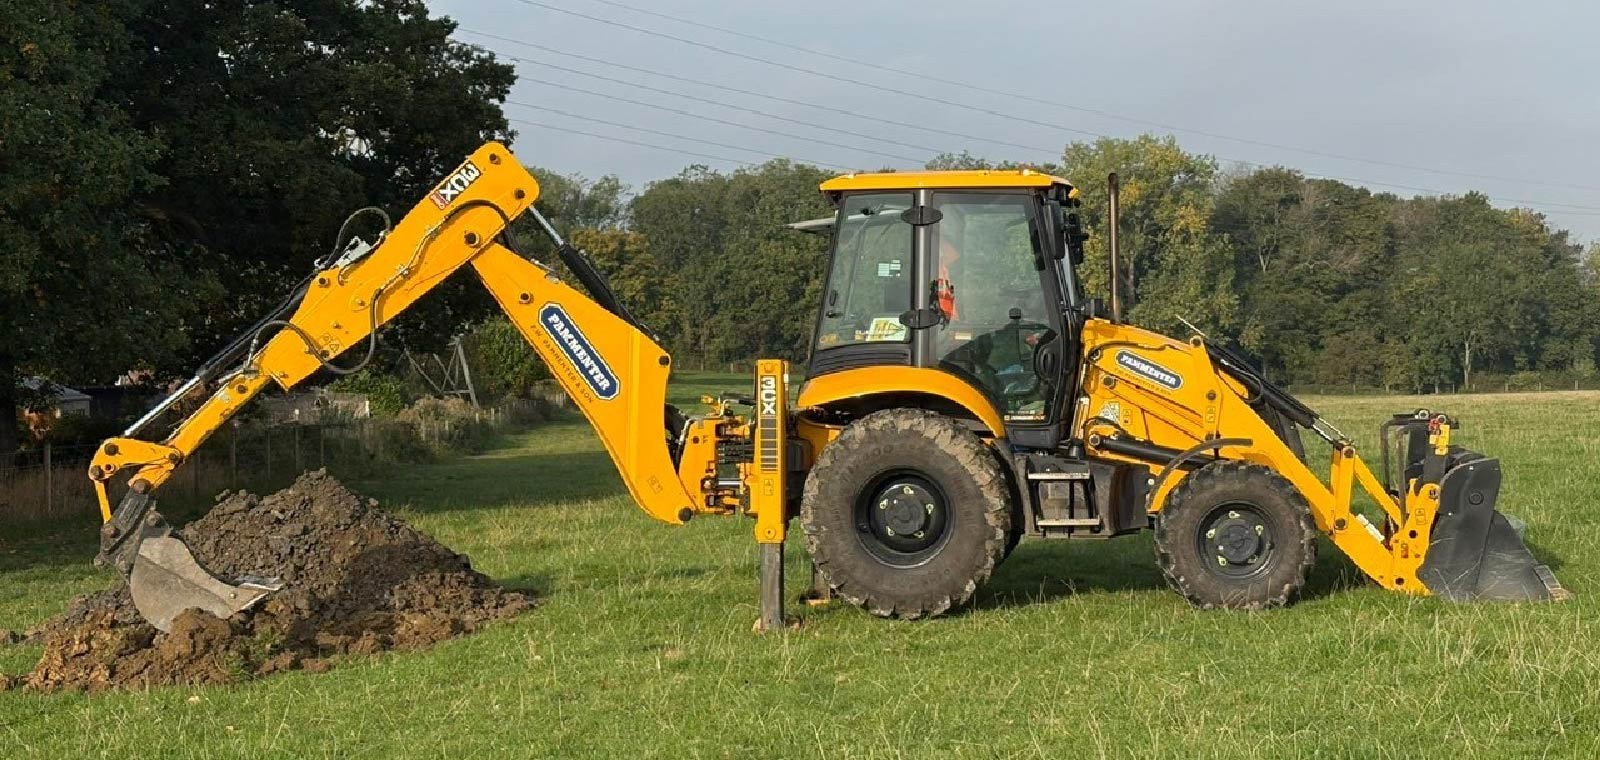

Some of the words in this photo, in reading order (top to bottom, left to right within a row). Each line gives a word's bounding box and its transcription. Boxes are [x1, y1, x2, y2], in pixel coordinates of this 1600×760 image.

[438, 163, 480, 202] 3CX
[547, 313, 611, 391] PAMMENTER
[1120, 354, 1177, 386] PAMMENTER
[760, 376, 776, 415] 3CX
